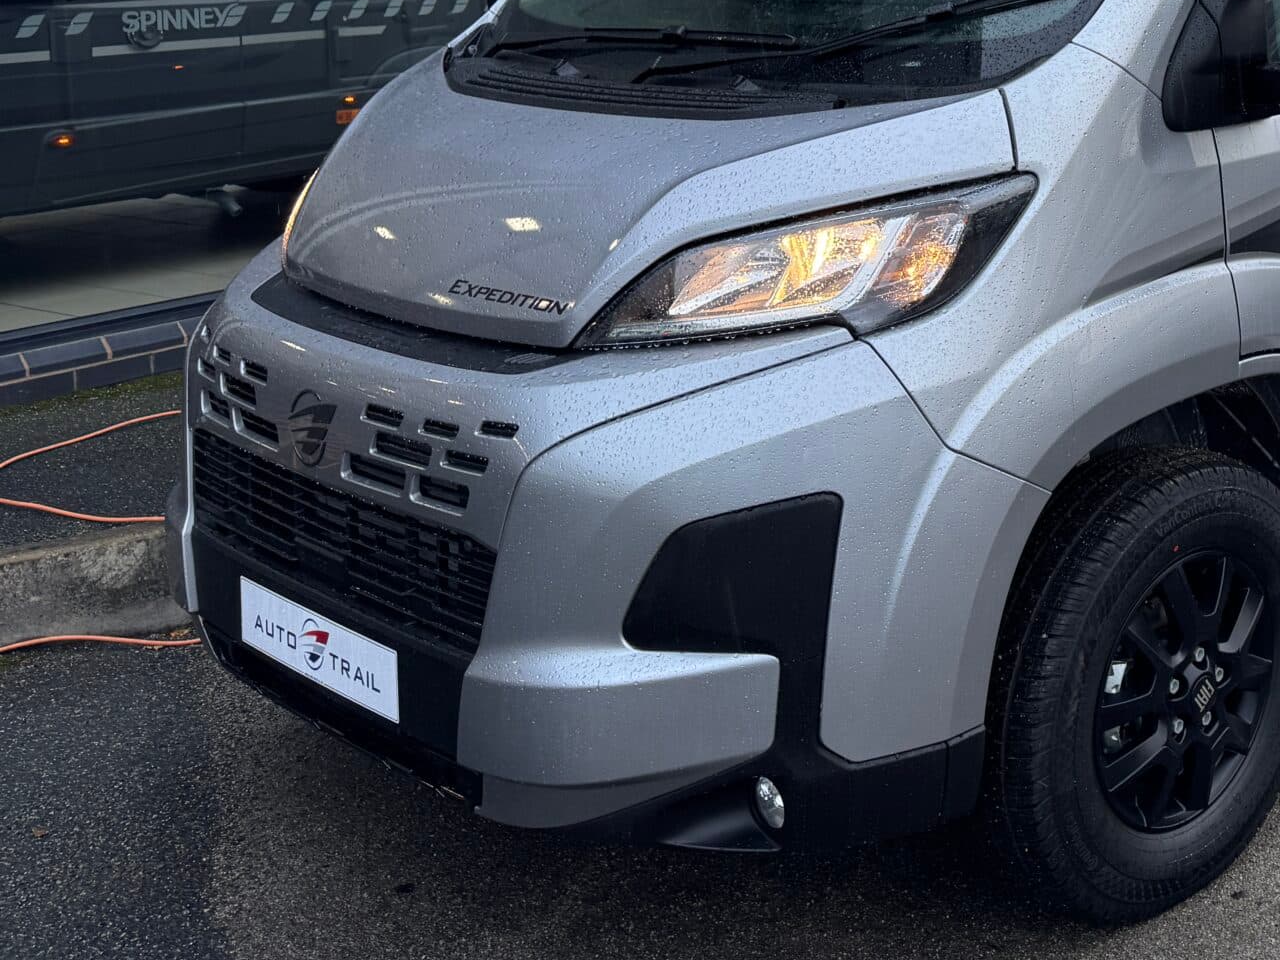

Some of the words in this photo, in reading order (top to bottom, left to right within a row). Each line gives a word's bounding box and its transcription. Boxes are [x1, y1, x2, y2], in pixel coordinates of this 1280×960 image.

[121, 2, 240, 33] SPINNEY
[448, 279, 569, 315] EXPEDITION
[254, 614, 297, 650] AUTO
[329, 652, 381, 693] TRAIL
[1194, 679, 1215, 713] FIAT
